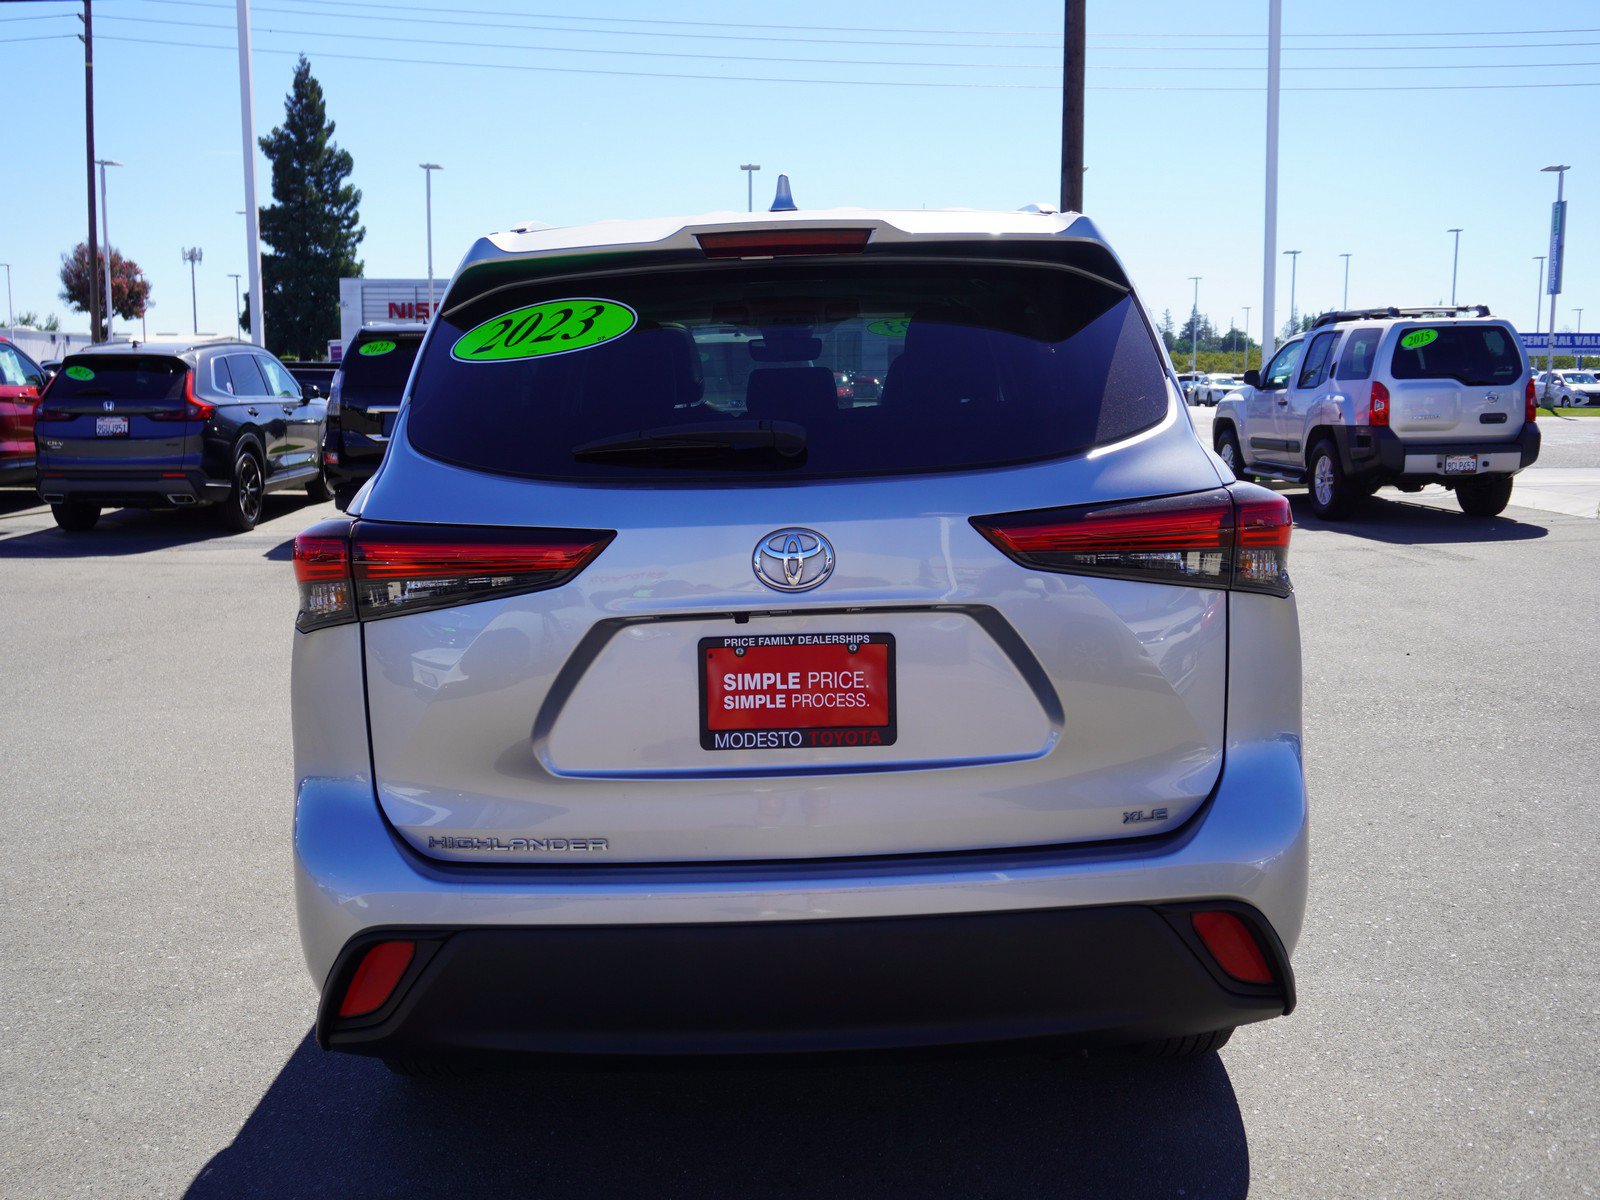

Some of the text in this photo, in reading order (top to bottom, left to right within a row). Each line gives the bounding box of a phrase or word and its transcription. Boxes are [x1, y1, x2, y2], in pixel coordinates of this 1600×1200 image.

[470, 305, 606, 355] 2023
[1407, 330, 1431, 347] 2015
[364, 342, 390, 354] 2022
[724, 634, 870, 647] PRICE FAMILY DEALERSHIPS
[723, 671, 870, 691] SIMPLE PRICE.
[723, 692, 870, 710] SIMPLE PROCESS.
[714, 729, 882, 749] MODESTO TOYOTA
[1124, 808, 1168, 822] XLE
[428, 835, 609, 852] HIGHLANDER
